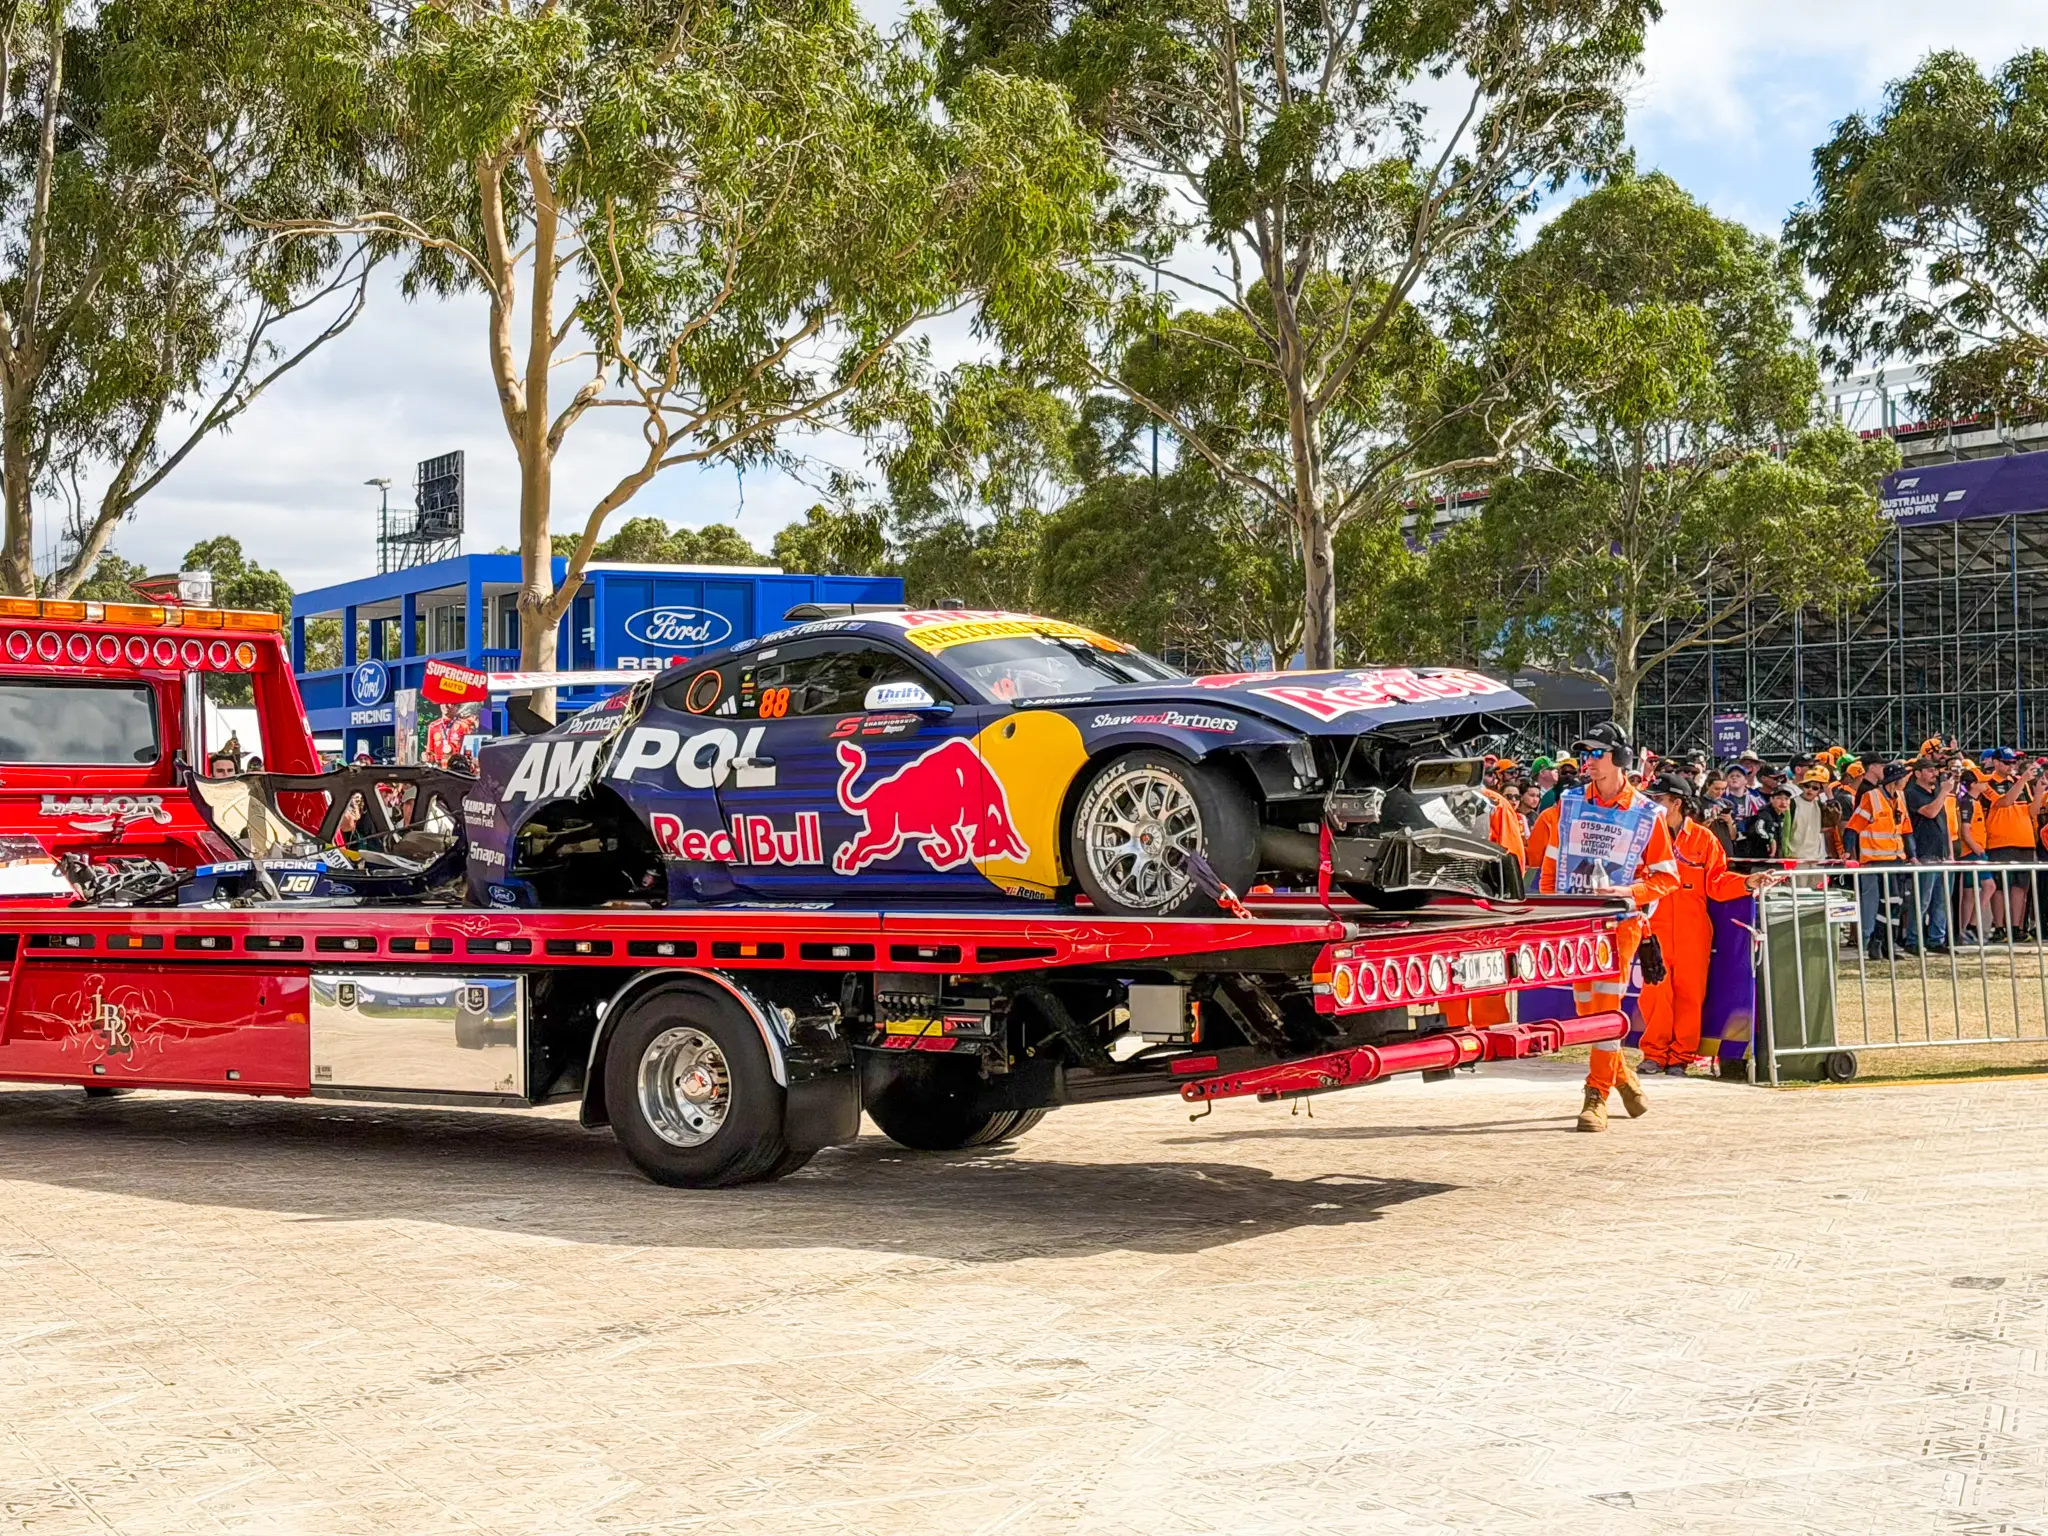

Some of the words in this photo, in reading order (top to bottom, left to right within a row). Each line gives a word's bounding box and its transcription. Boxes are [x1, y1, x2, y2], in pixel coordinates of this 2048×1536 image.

[1880, 493, 1939, 508] AUSTRALIAN
[1882, 506, 1914, 519] GRAND
[1914, 504, 1937, 516] PRIX
[646, 611, 712, 642] Ford
[761, 627, 798, 644] BROC
[796, 622, 849, 635] FEENEY
[617, 656, 674, 669] RAC
[358, 667, 380, 698] Ford
[426, 660, 487, 688] SUPERCHEAP
[442, 680, 464, 692] AUTO
[877, 687, 926, 700] Thrifty
[759, 687, 791, 719] 88
[351, 708, 393, 725] RACING
[562, 714, 623, 735] Partners
[1718, 731, 1741, 741] FAN-B
[650, 812, 748, 866] Red
[746, 811, 824, 866] Bull
[470, 841, 505, 867] Snap-on
[212, 863, 252, 873] FOR
[262, 861, 317, 871] RACING
[280, 876, 315, 892] JGI
